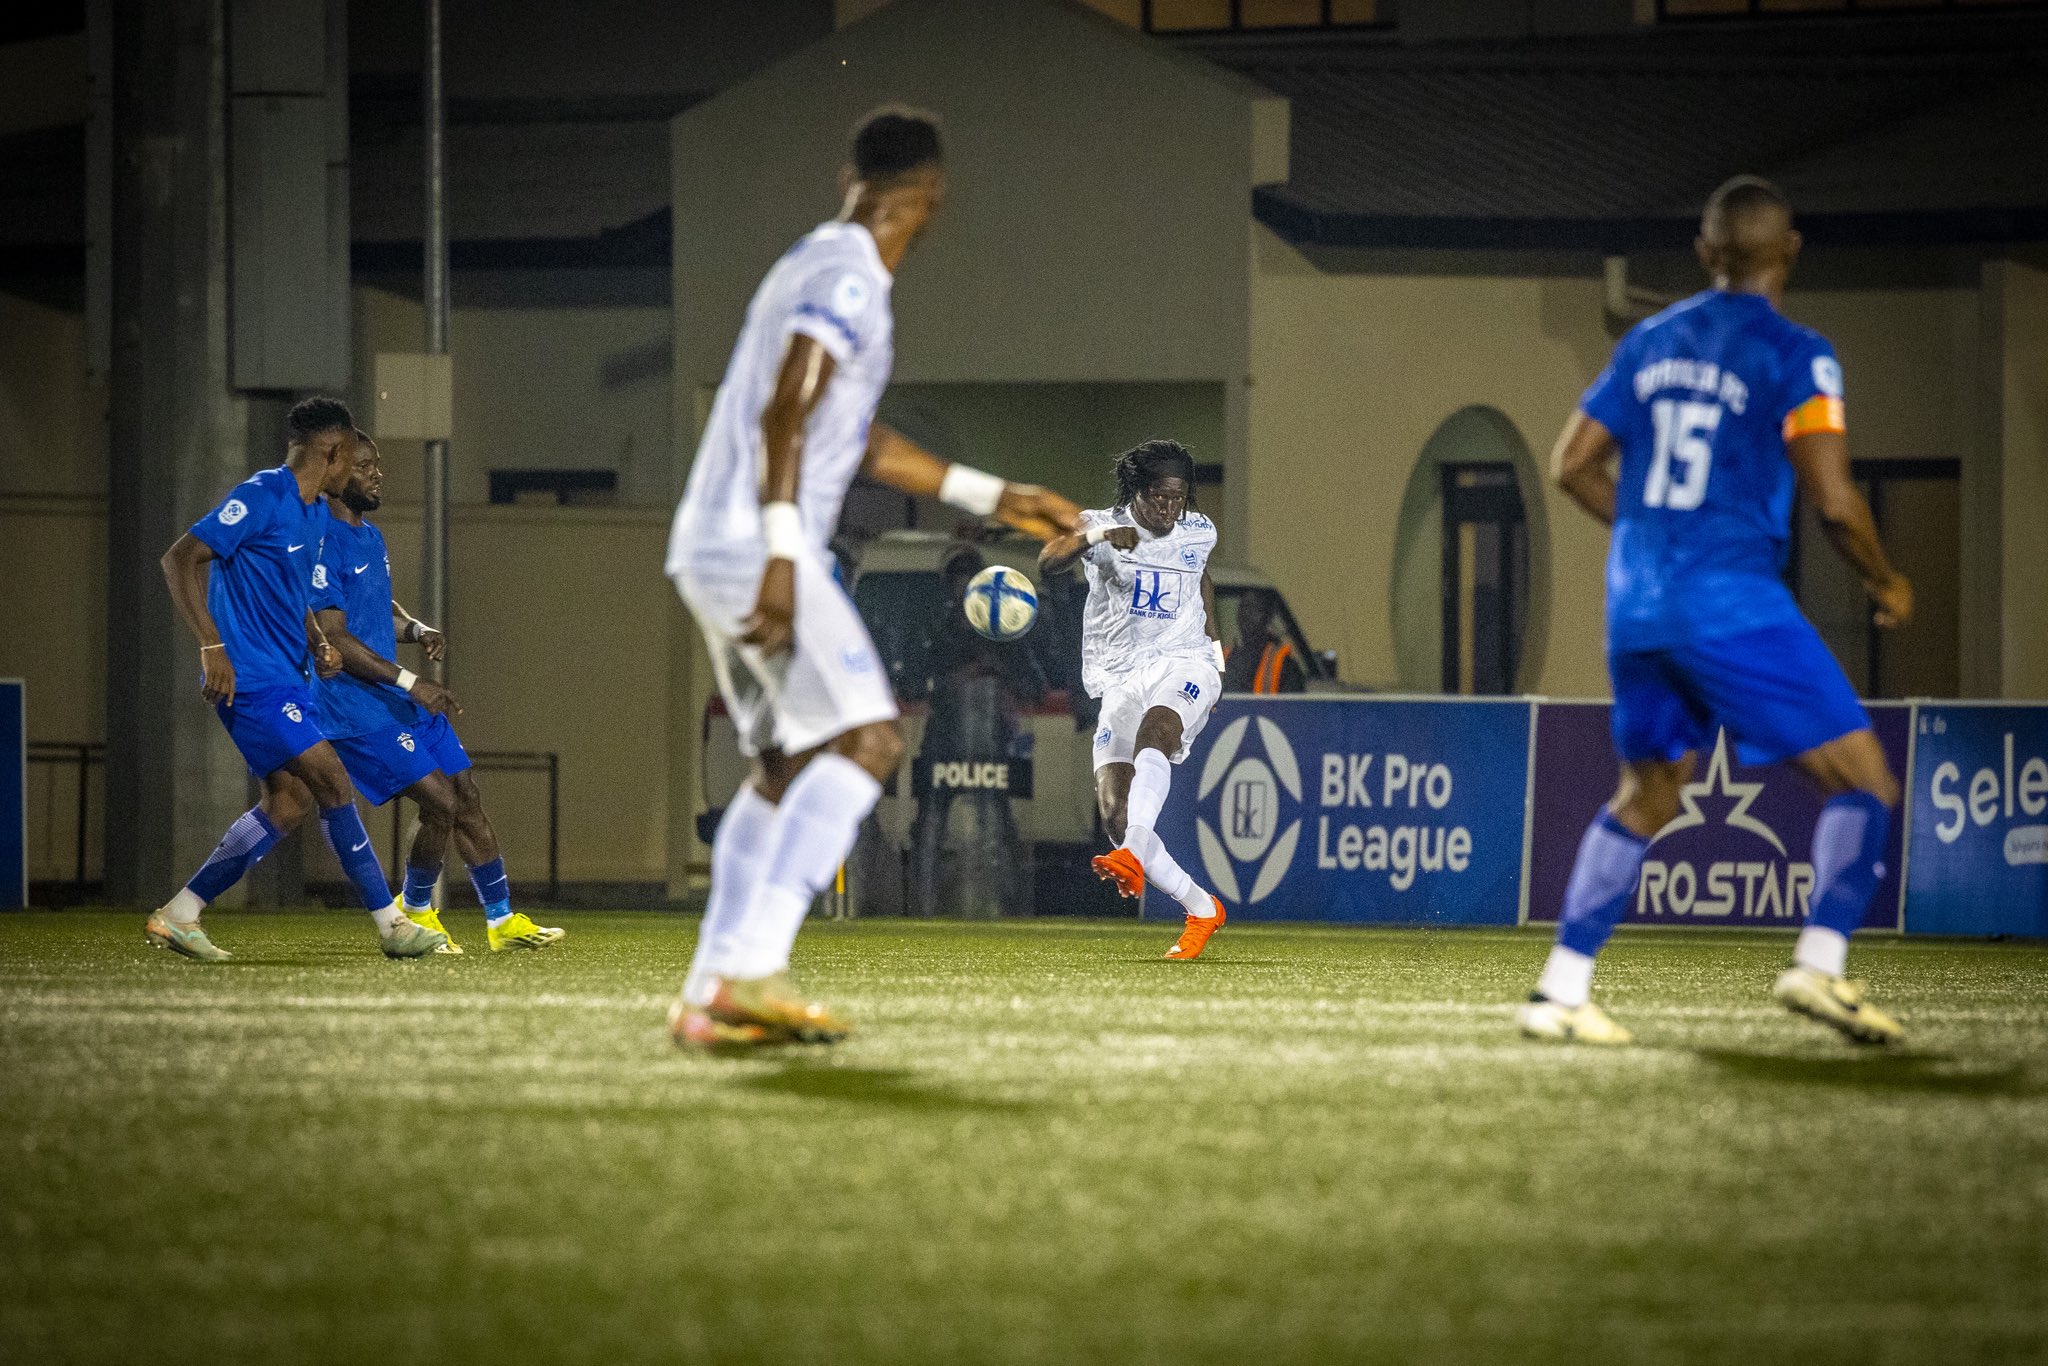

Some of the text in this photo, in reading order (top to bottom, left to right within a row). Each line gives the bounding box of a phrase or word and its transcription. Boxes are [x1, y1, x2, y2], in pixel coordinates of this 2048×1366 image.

[1642, 399, 1722, 511] 15
[1130, 608, 1147, 618] BANK
[1148, 611, 1157, 619] OF
[1184, 681, 1200, 700] 18
[932, 762, 1009, 789] POLICE
[1321, 753, 1453, 810] BK Pro
[1931, 733, 2048, 843] Sele
[1317, 815, 1473, 892] League
